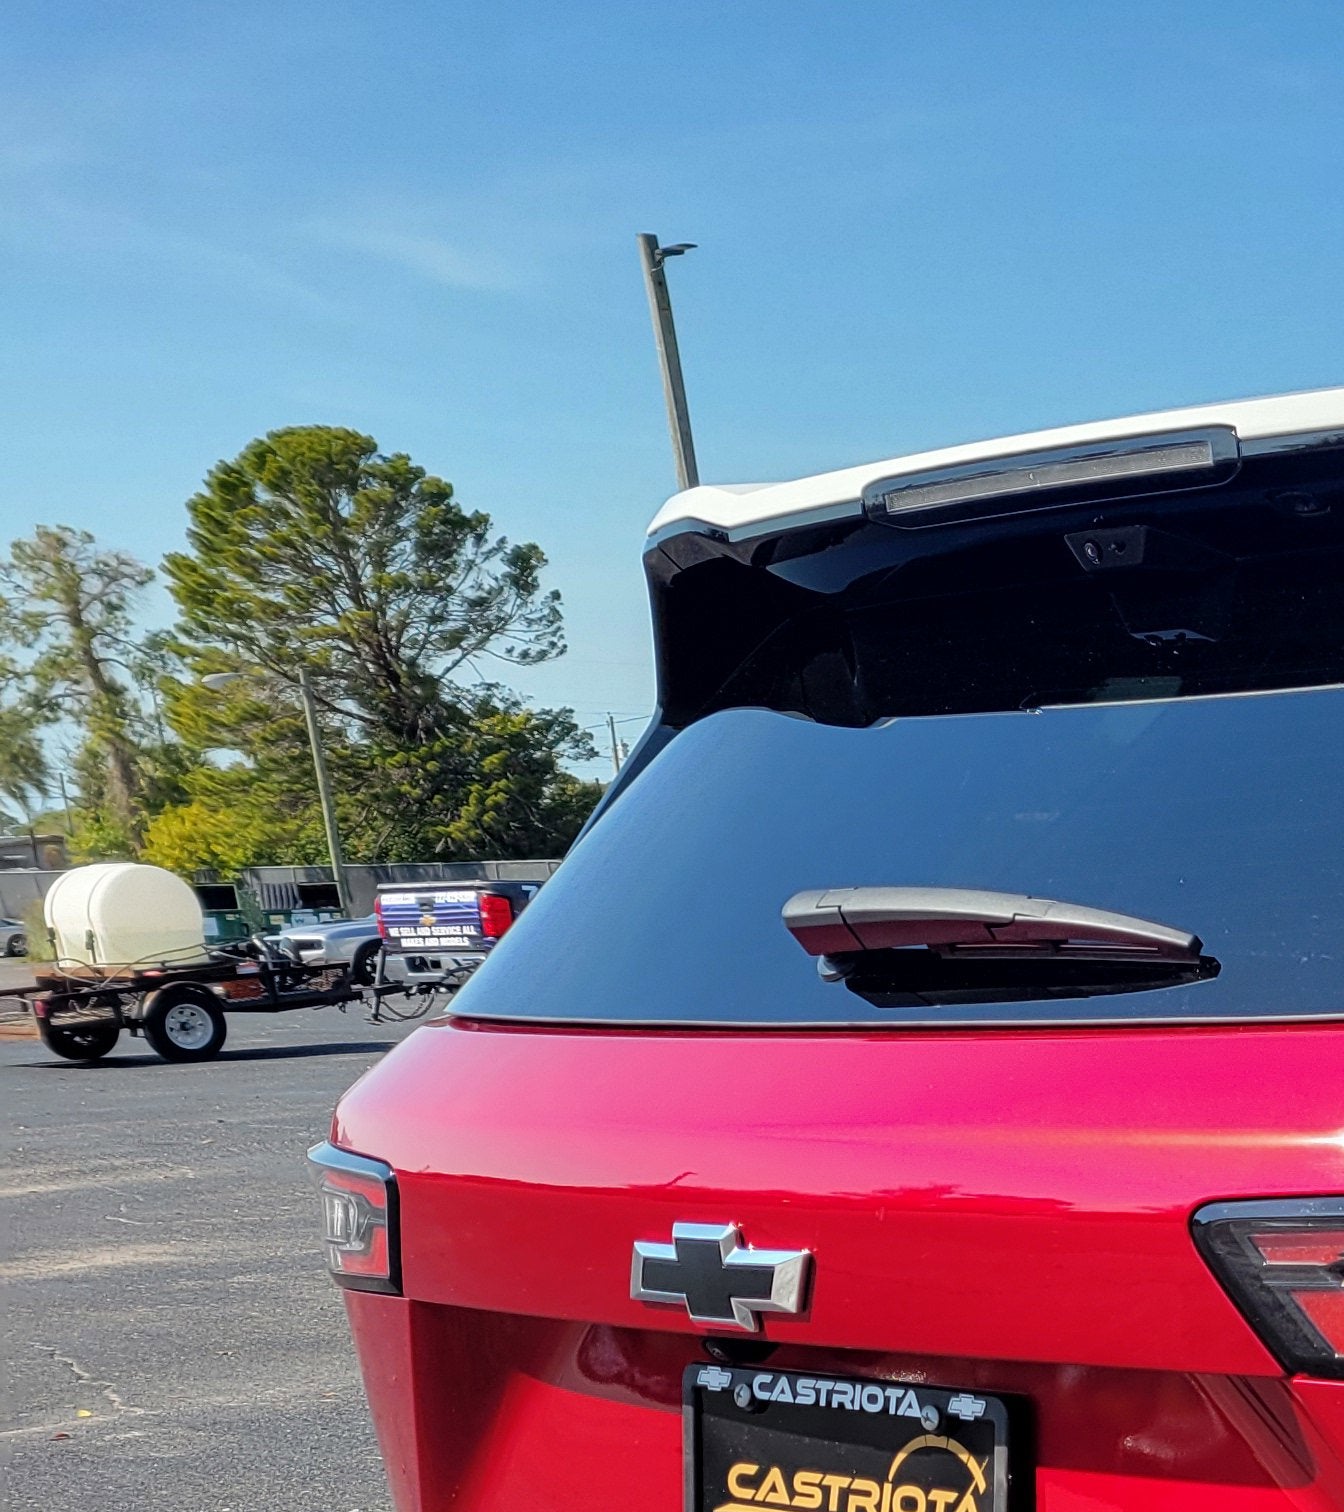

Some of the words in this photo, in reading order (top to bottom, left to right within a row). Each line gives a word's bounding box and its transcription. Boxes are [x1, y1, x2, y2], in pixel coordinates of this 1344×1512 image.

[400, 927, 417, 936] SELL
[417, 926, 431, 936] AND
[431, 926, 462, 936] SERVICE
[463, 925, 478, 935] ALL
[401, 938, 424, 948] MAKES
[425, 937, 439, 947] AND
[439, 937, 470, 947] MODELS
[752, 1374, 923, 1417] CASTRIOTA
